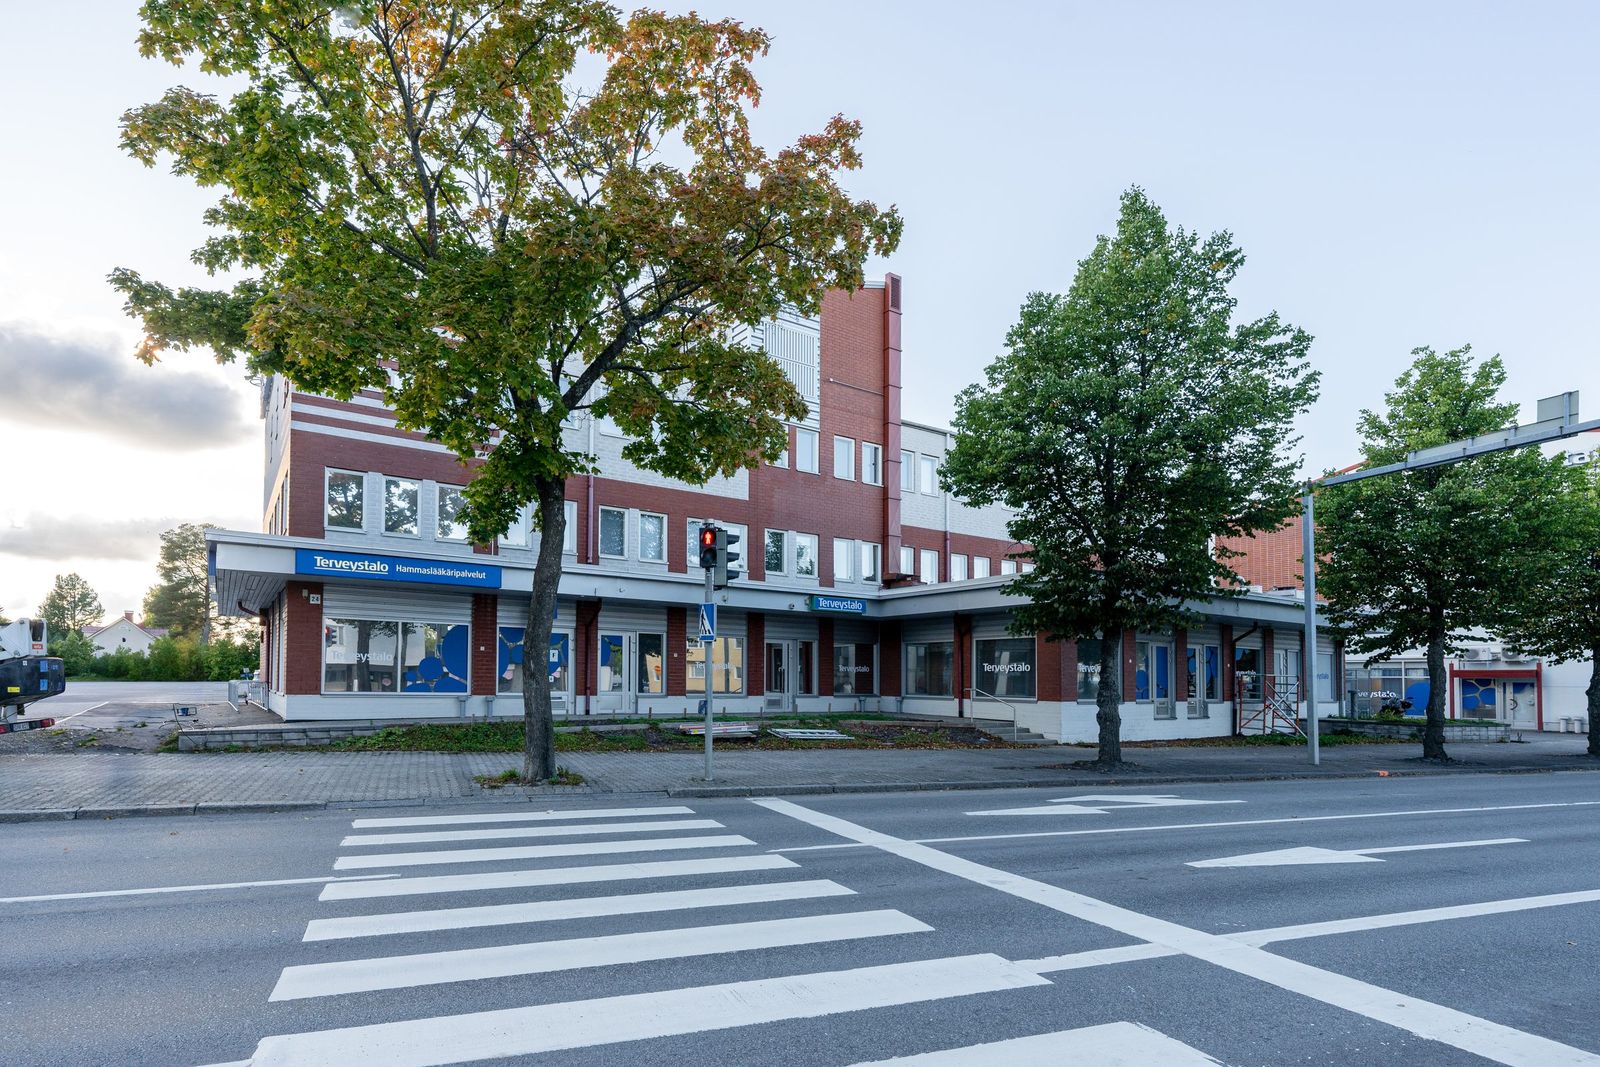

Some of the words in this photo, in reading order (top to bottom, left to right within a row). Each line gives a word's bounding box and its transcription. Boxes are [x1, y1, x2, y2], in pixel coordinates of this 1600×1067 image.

[314, 556, 389, 572] Terveystalo
[396, 564, 486, 579] Hammaslääkäripalvelut
[818, 597, 863, 610] Terveystalo
[839, 664, 870, 673] Terveystalo
[983, 662, 1031, 674] Terveystalo
